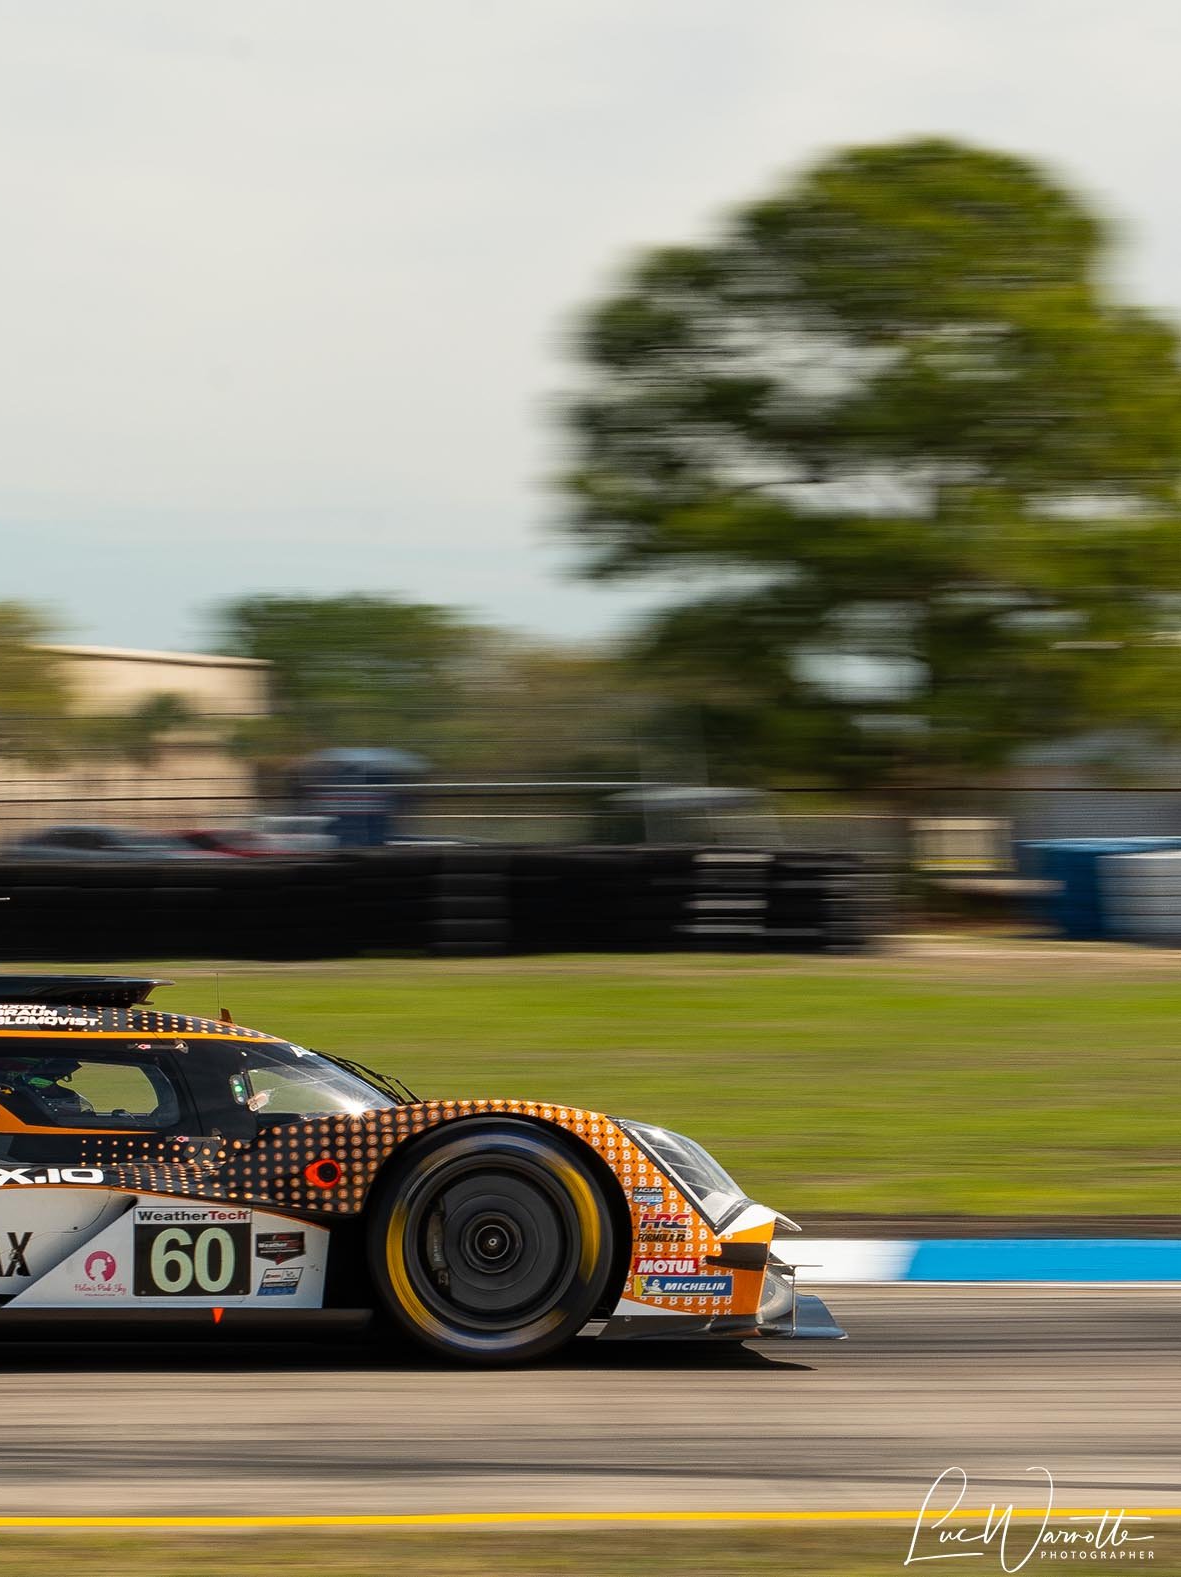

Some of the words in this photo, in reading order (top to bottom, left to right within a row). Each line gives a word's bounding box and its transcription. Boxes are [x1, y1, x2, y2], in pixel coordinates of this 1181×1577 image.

[138, 1210, 248, 1221] WeatherTech
[150, 1227, 235, 1292] 60
[636, 1260, 697, 1274] MOTUL
[664, 1282, 727, 1291] MICHELIN
